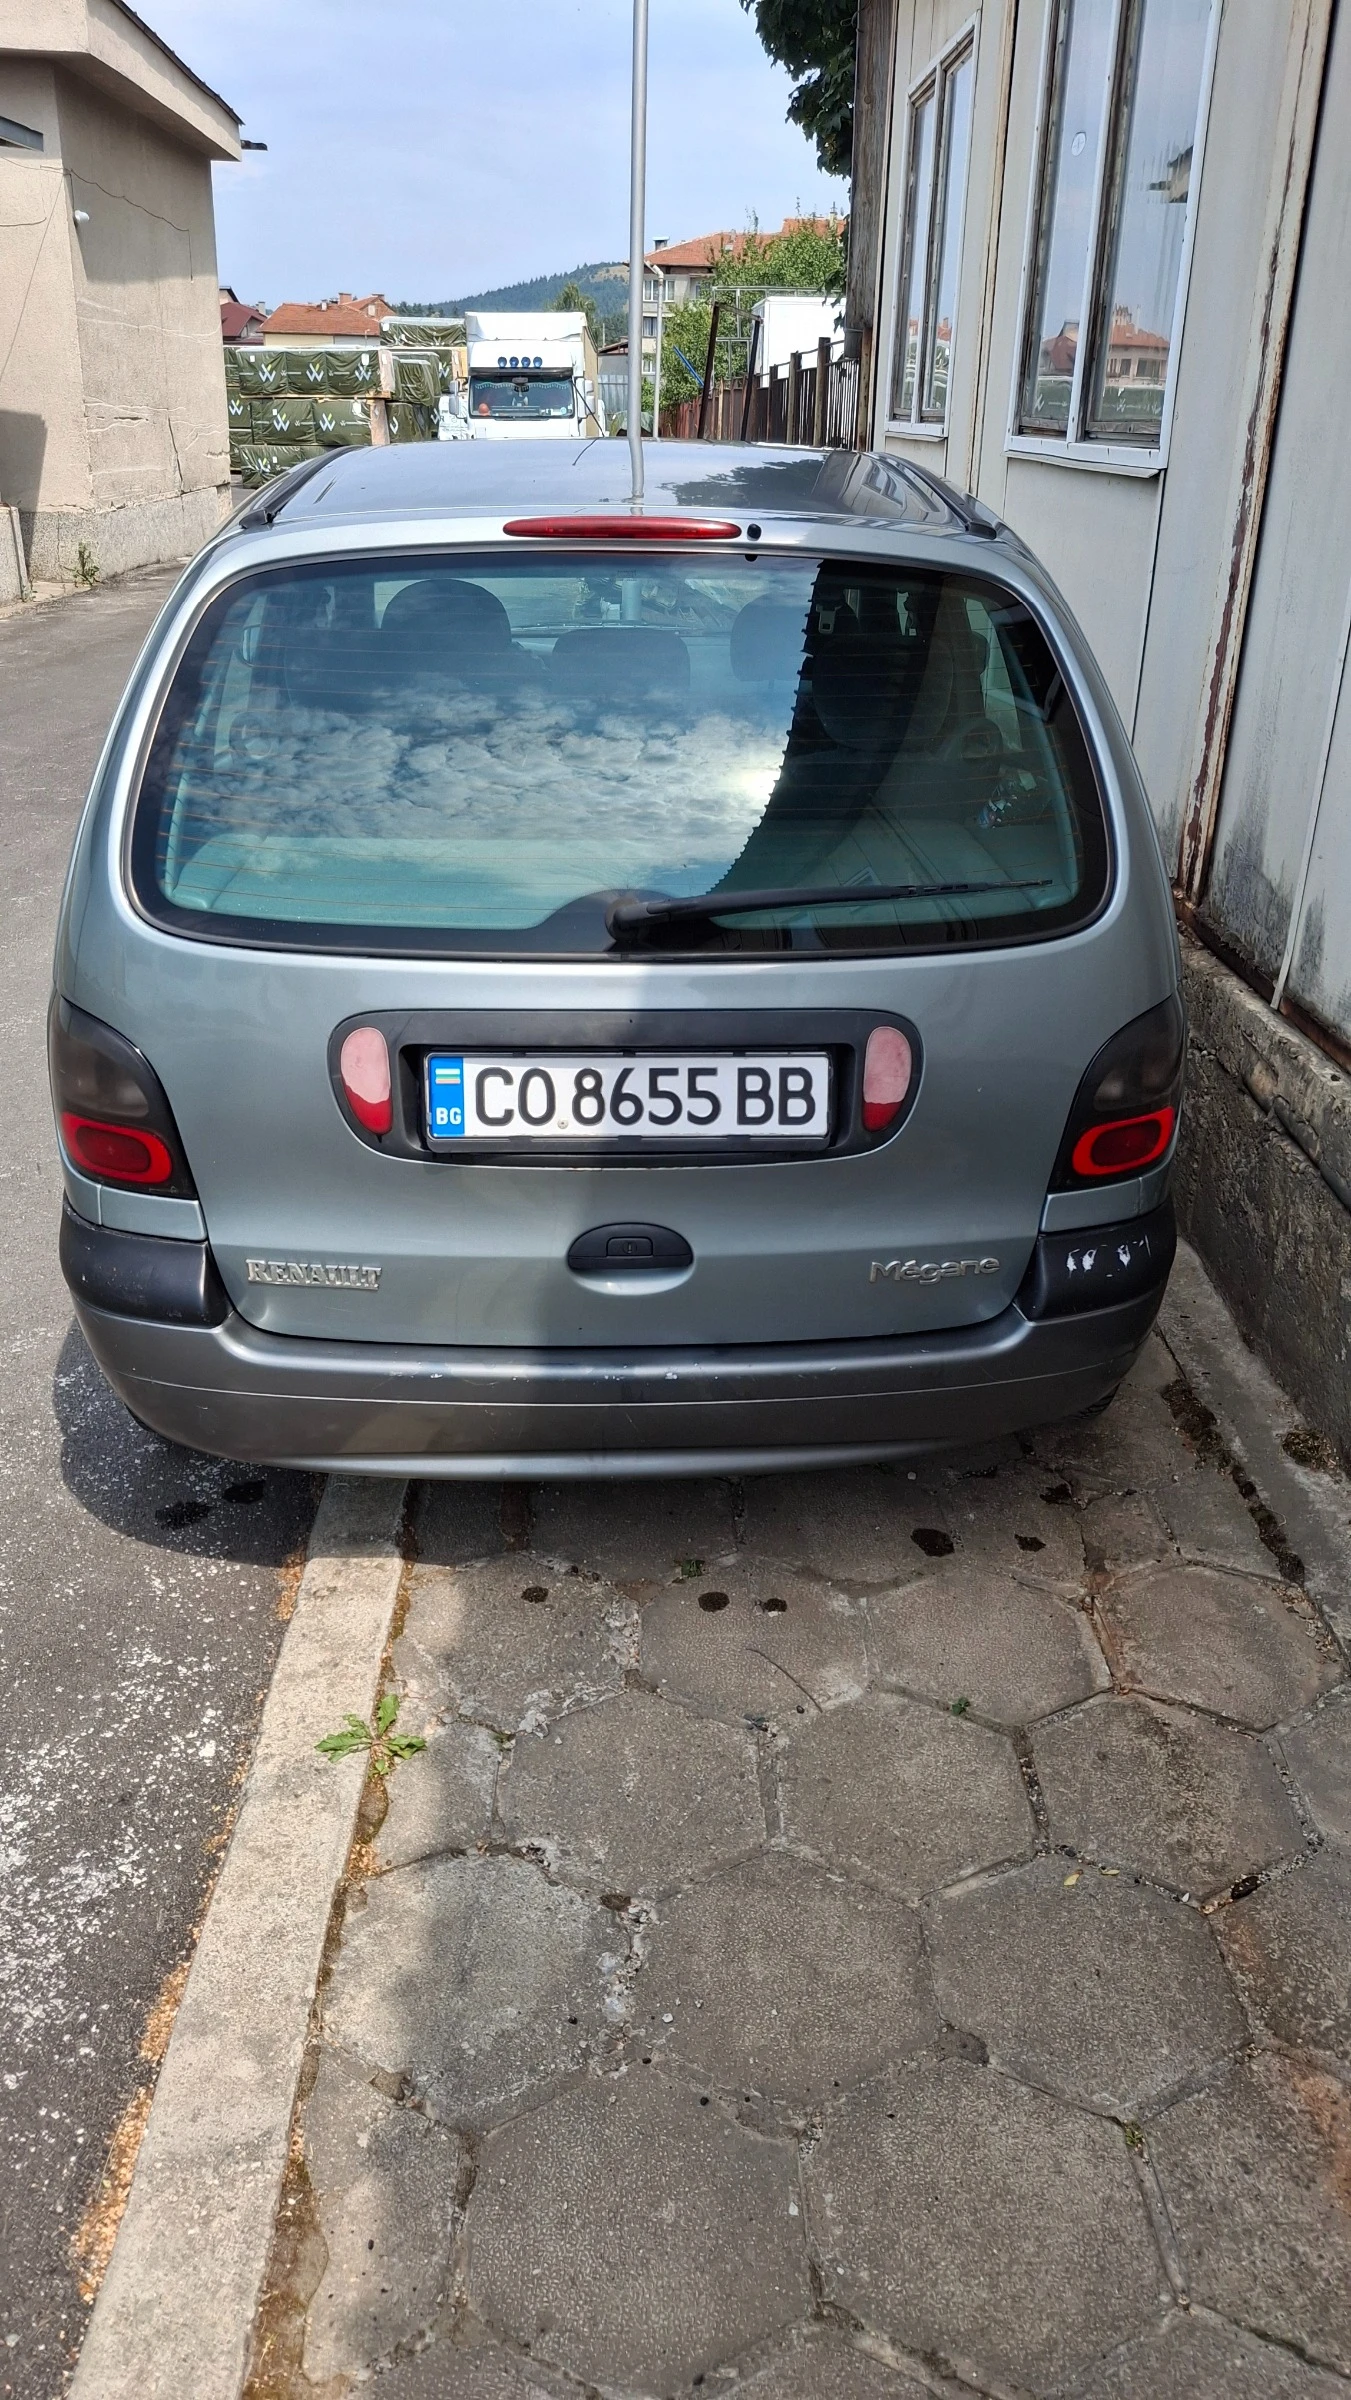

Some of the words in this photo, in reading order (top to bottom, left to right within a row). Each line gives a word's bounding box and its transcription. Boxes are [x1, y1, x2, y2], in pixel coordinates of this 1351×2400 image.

[475, 1066, 556, 1127] CO
[571, 1066, 722, 1127] 8655
[736, 1067, 817, 1126] BB
[435, 1107, 462, 1126] BG
[245, 1258, 382, 1290] RENAULT
[868, 1257, 1001, 1286] Mégane
